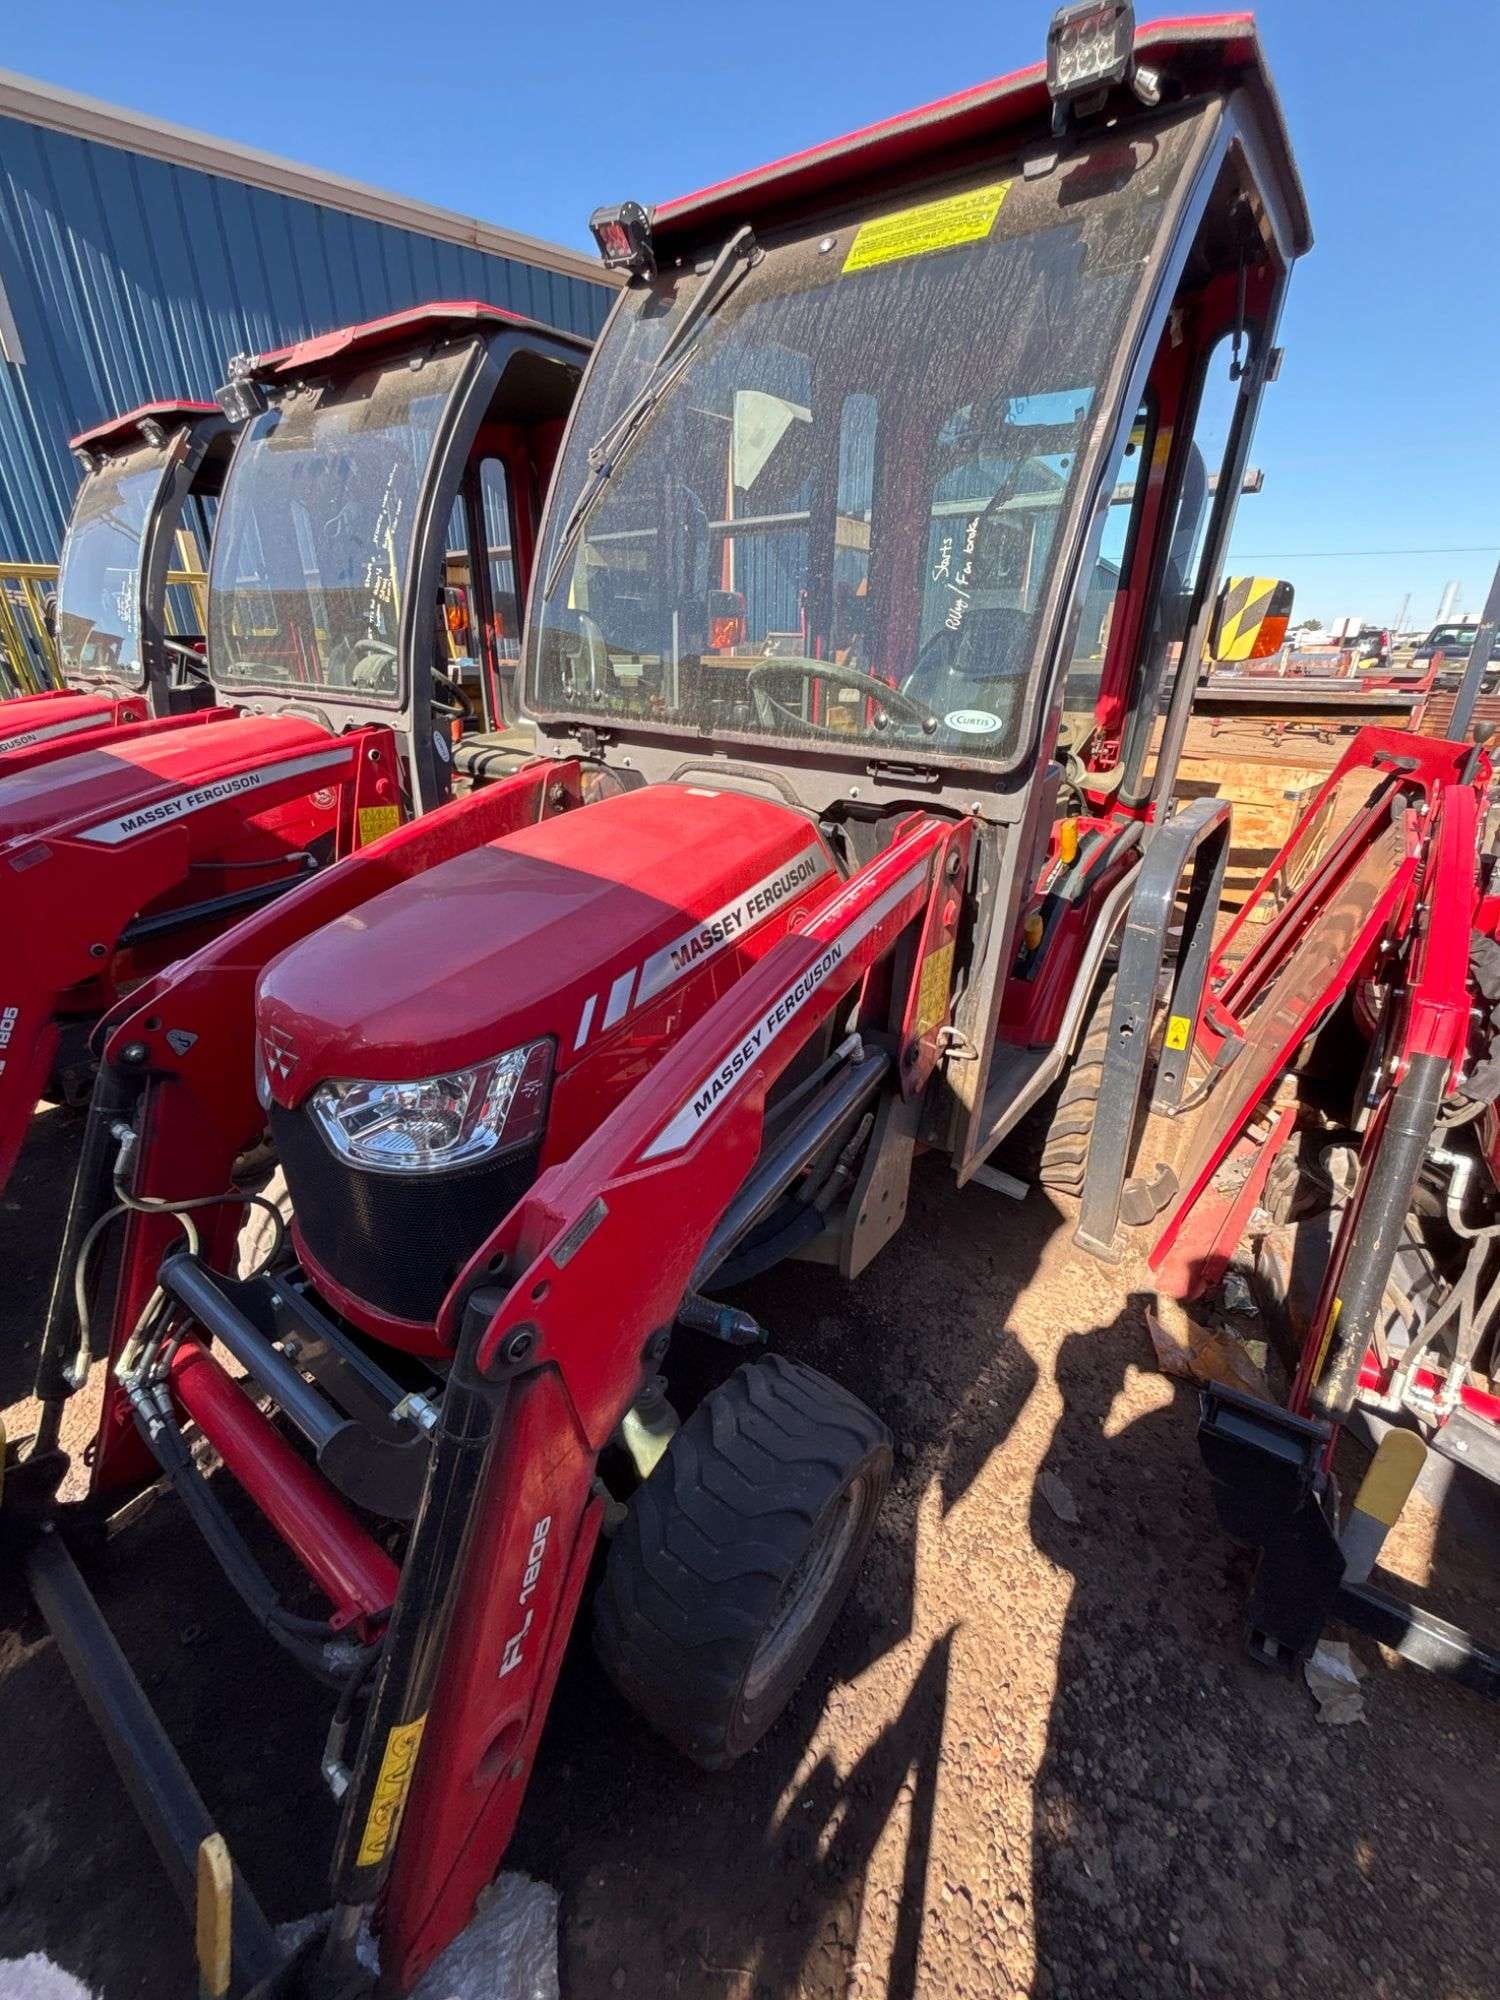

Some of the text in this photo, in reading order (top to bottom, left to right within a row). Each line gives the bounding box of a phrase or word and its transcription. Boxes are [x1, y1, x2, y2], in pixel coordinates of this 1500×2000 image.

[932, 537, 953, 581] Starts
[0, 733, 37, 752] GUSON
[956, 715, 990, 726] CURTIS
[120, 773, 261, 833] MASSEY FERGUSON
[669, 856, 817, 971] MASSEY FERGUSON
[692, 943, 842, 1119] MASSEY FERGUSON
